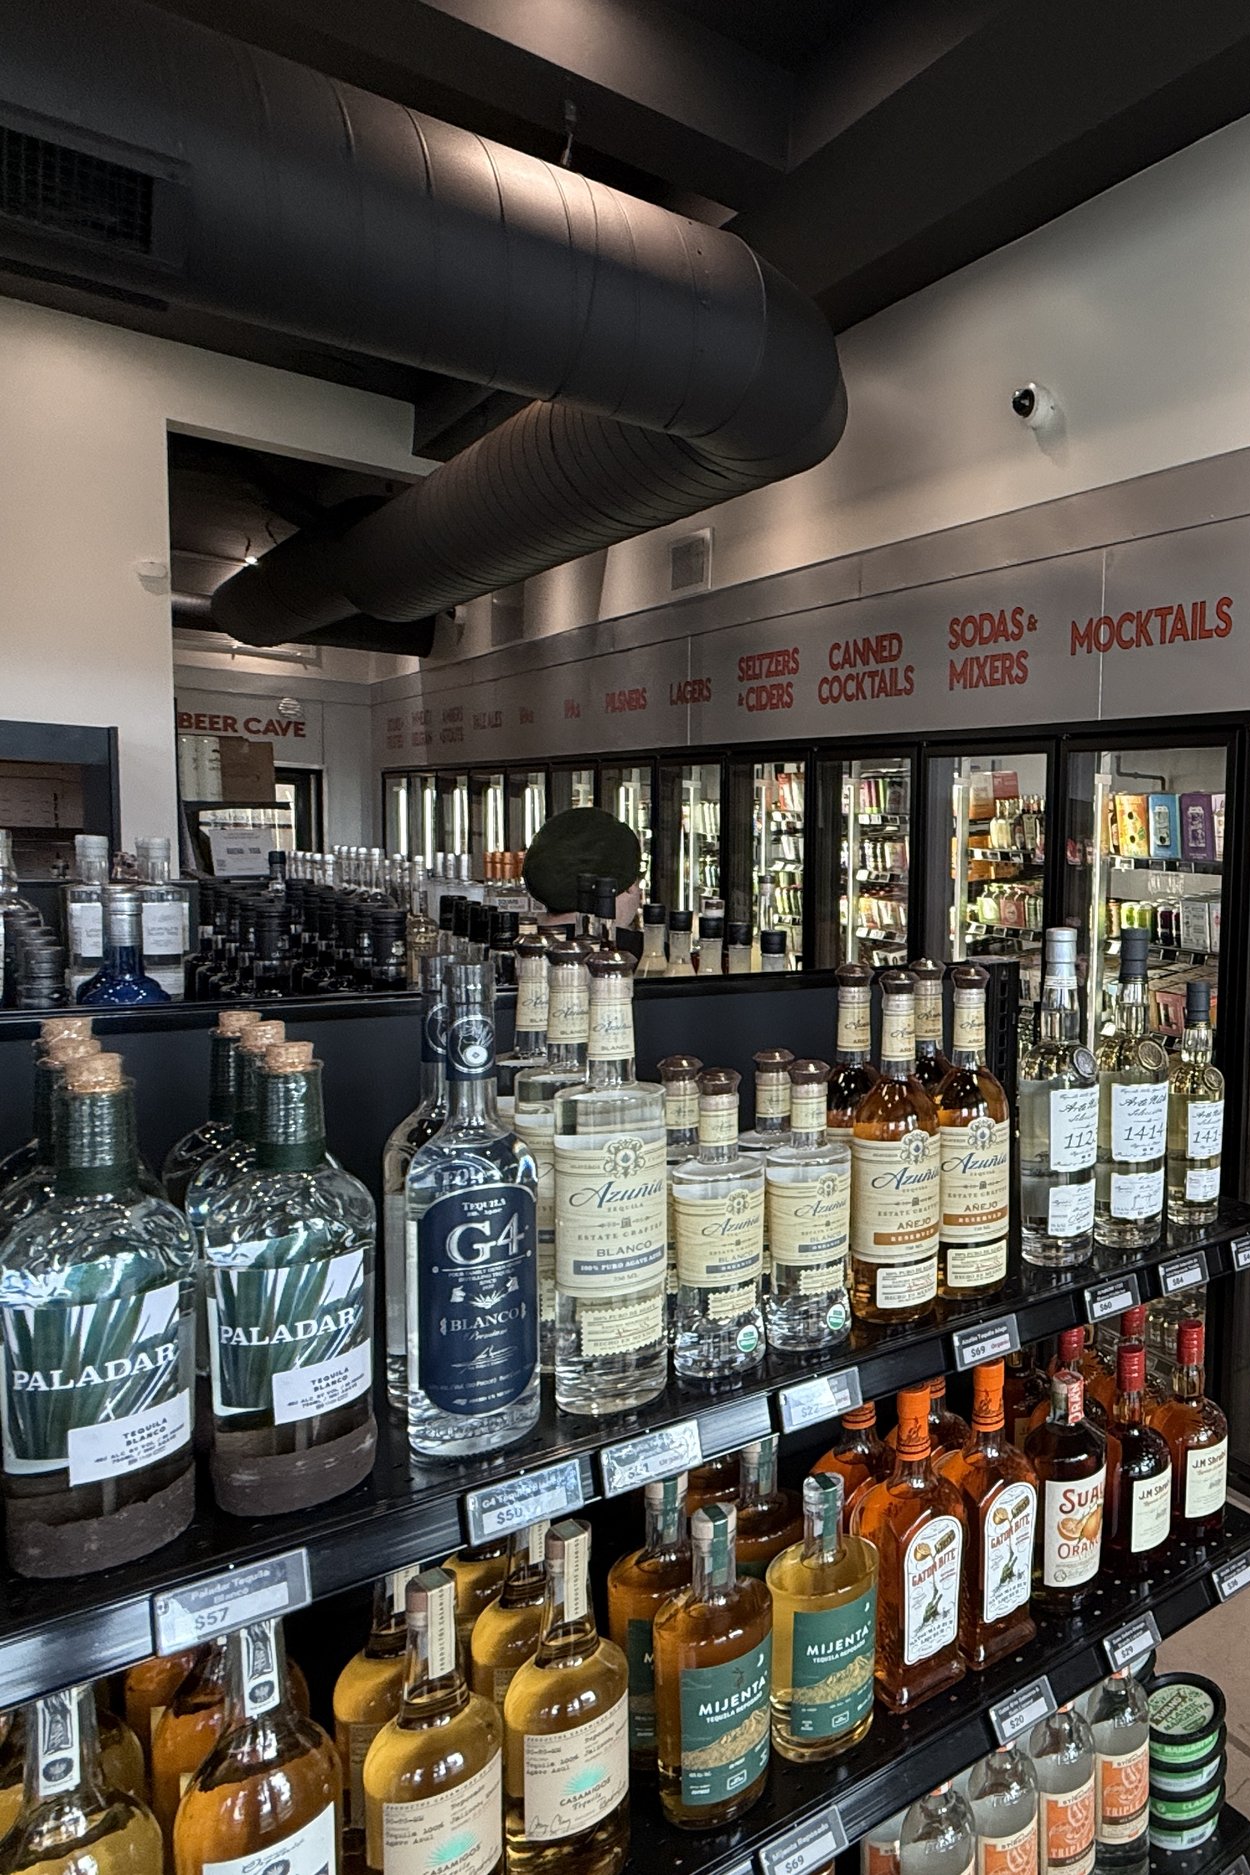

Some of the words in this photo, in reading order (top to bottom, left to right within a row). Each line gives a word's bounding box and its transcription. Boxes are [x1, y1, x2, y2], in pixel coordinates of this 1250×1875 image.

[948, 607, 1025, 651] SODAS
[1026, 617, 1038, 634] &
[1070, 597, 1234, 656] MOCKTAILS
[828, 632, 903, 671] CANNED
[737, 647, 800, 682] SELTZERS
[949, 650, 1029, 692] MIXERS
[669, 677, 712, 706] LAGERS
[746, 682, 794, 713] CIDERS
[818, 665, 915, 705] COCKTAILS
[605, 687, 647, 713] PILSNERS
[177, 711, 238, 733] BEER
[243, 717, 307, 738] CAVE
[941, 1151, 1008, 1175] Azuñia
[871, 1166, 940, 1191] Azuñia
[461, 1198, 508, 1212] TEQUILA
[568, 1179, 664, 1209] Azuñia
[963, 1200, 998, 1213] AÑEJO
[896, 1216, 932, 1231] AÑEJO
[446, 1212, 526, 1266] G4
[596, 1240, 652, 1257] BLANCO
[601, 1261, 624, 1271] PURO
[625, 1256, 648, 1268] AGAVE
[1172, 1276, 1184, 1286] $84
[1099, 1301, 1113, 1312] $60
[219, 1305, 356, 1347] PALADAR
[450, 1307, 520, 1332] BLANCO
[970, 1345, 987, 1359] $69
[12, 1341, 178, 1392] PALADAR
[310, 1367, 349, 1386] TEQUILA
[313, 1374, 348, 1393] BLANCO
[800, 1404, 821, 1419] $22
[122, 1417, 168, 1440] TEQUILA
[125, 1426, 167, 1447] BLANCO
[990, 1525, 1014, 1549] GATOR
[1013, 1515, 1031, 1534] BITE
[1057, 1537, 1099, 1560] ORAN
[232, 1568, 272, 1586] Tequila
[911, 1561, 938, 1588] GATOR
[938, 1549, 956, 1569] BITE
[194, 1606, 230, 1632] $57
[806, 1628, 871, 1657] MIJENTA
[1120, 1645, 1134, 1659] $29
[812, 1652, 840, 1664] TEQUILA
[699, 1675, 766, 1717] MIJENTA
[706, 1709, 737, 1724] TEQUILA
[1009, 1714, 1025, 1730] $20
[559, 1776, 613, 1807] CASAMIGOS
[422, 1840, 482, 1875] CASAMIGOS
[784, 1854, 805, 1874] $69
